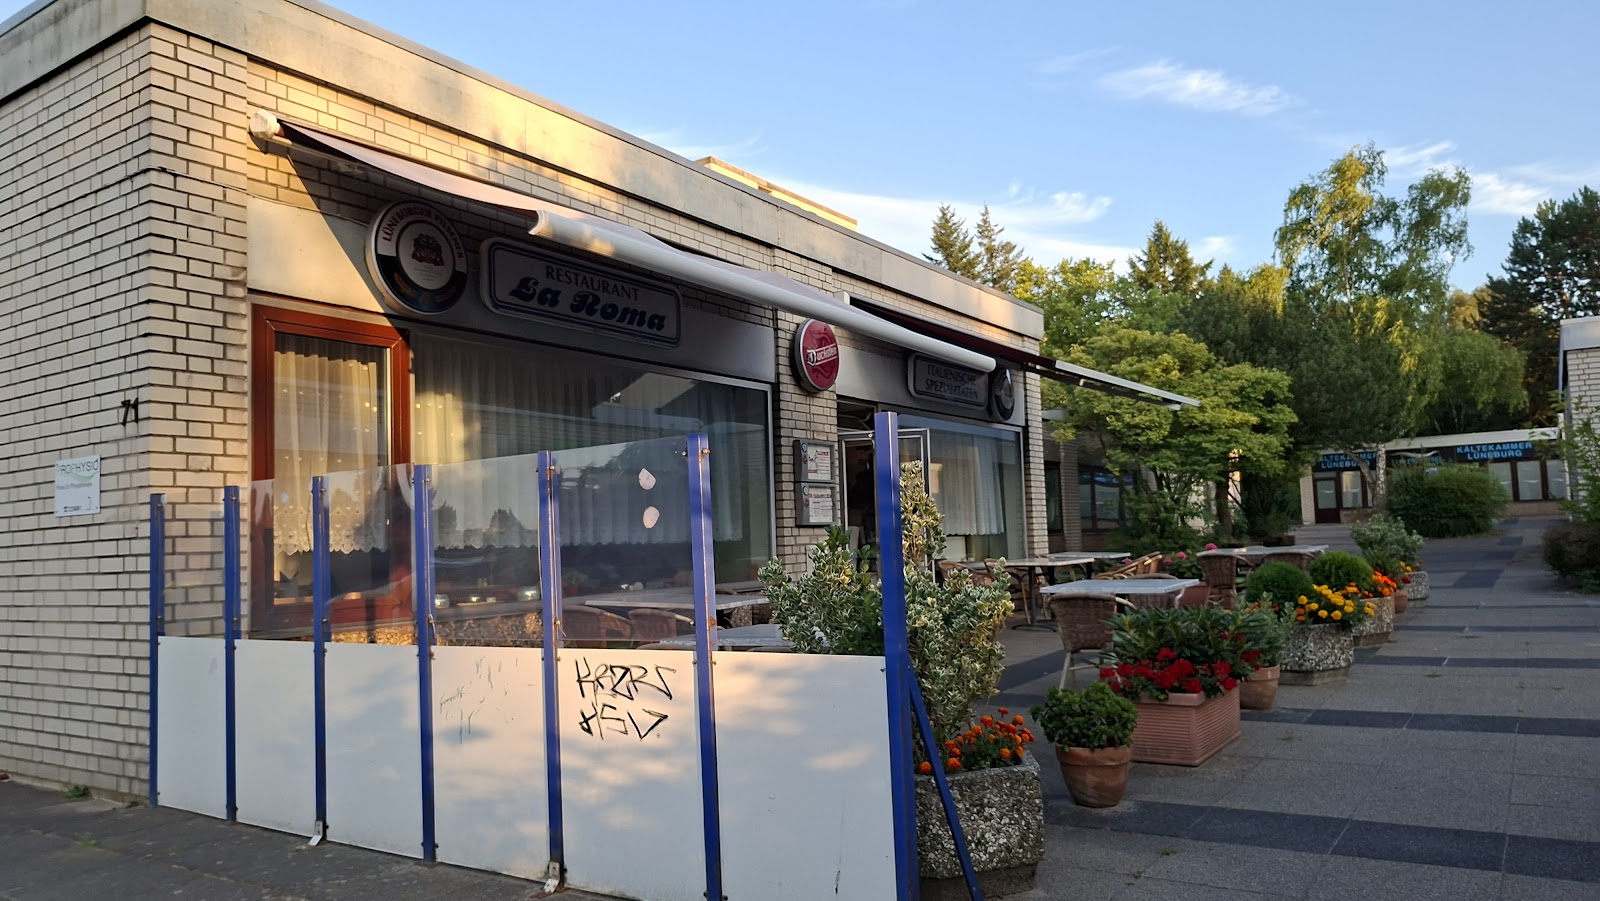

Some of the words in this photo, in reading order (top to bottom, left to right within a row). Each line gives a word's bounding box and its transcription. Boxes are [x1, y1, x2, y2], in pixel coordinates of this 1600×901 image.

[546, 265, 640, 301] RESTAURANT
[509, 276, 562, 308] La
[570, 290, 667, 332] Roma
[120, 396, 139, 427] 71
[1456, 441, 1533, 454] KÄLTEKAMMER
[1467, 449, 1523, 460] LÜNEBURG
[1320, 458, 1371, 470] LÜNEBUG
